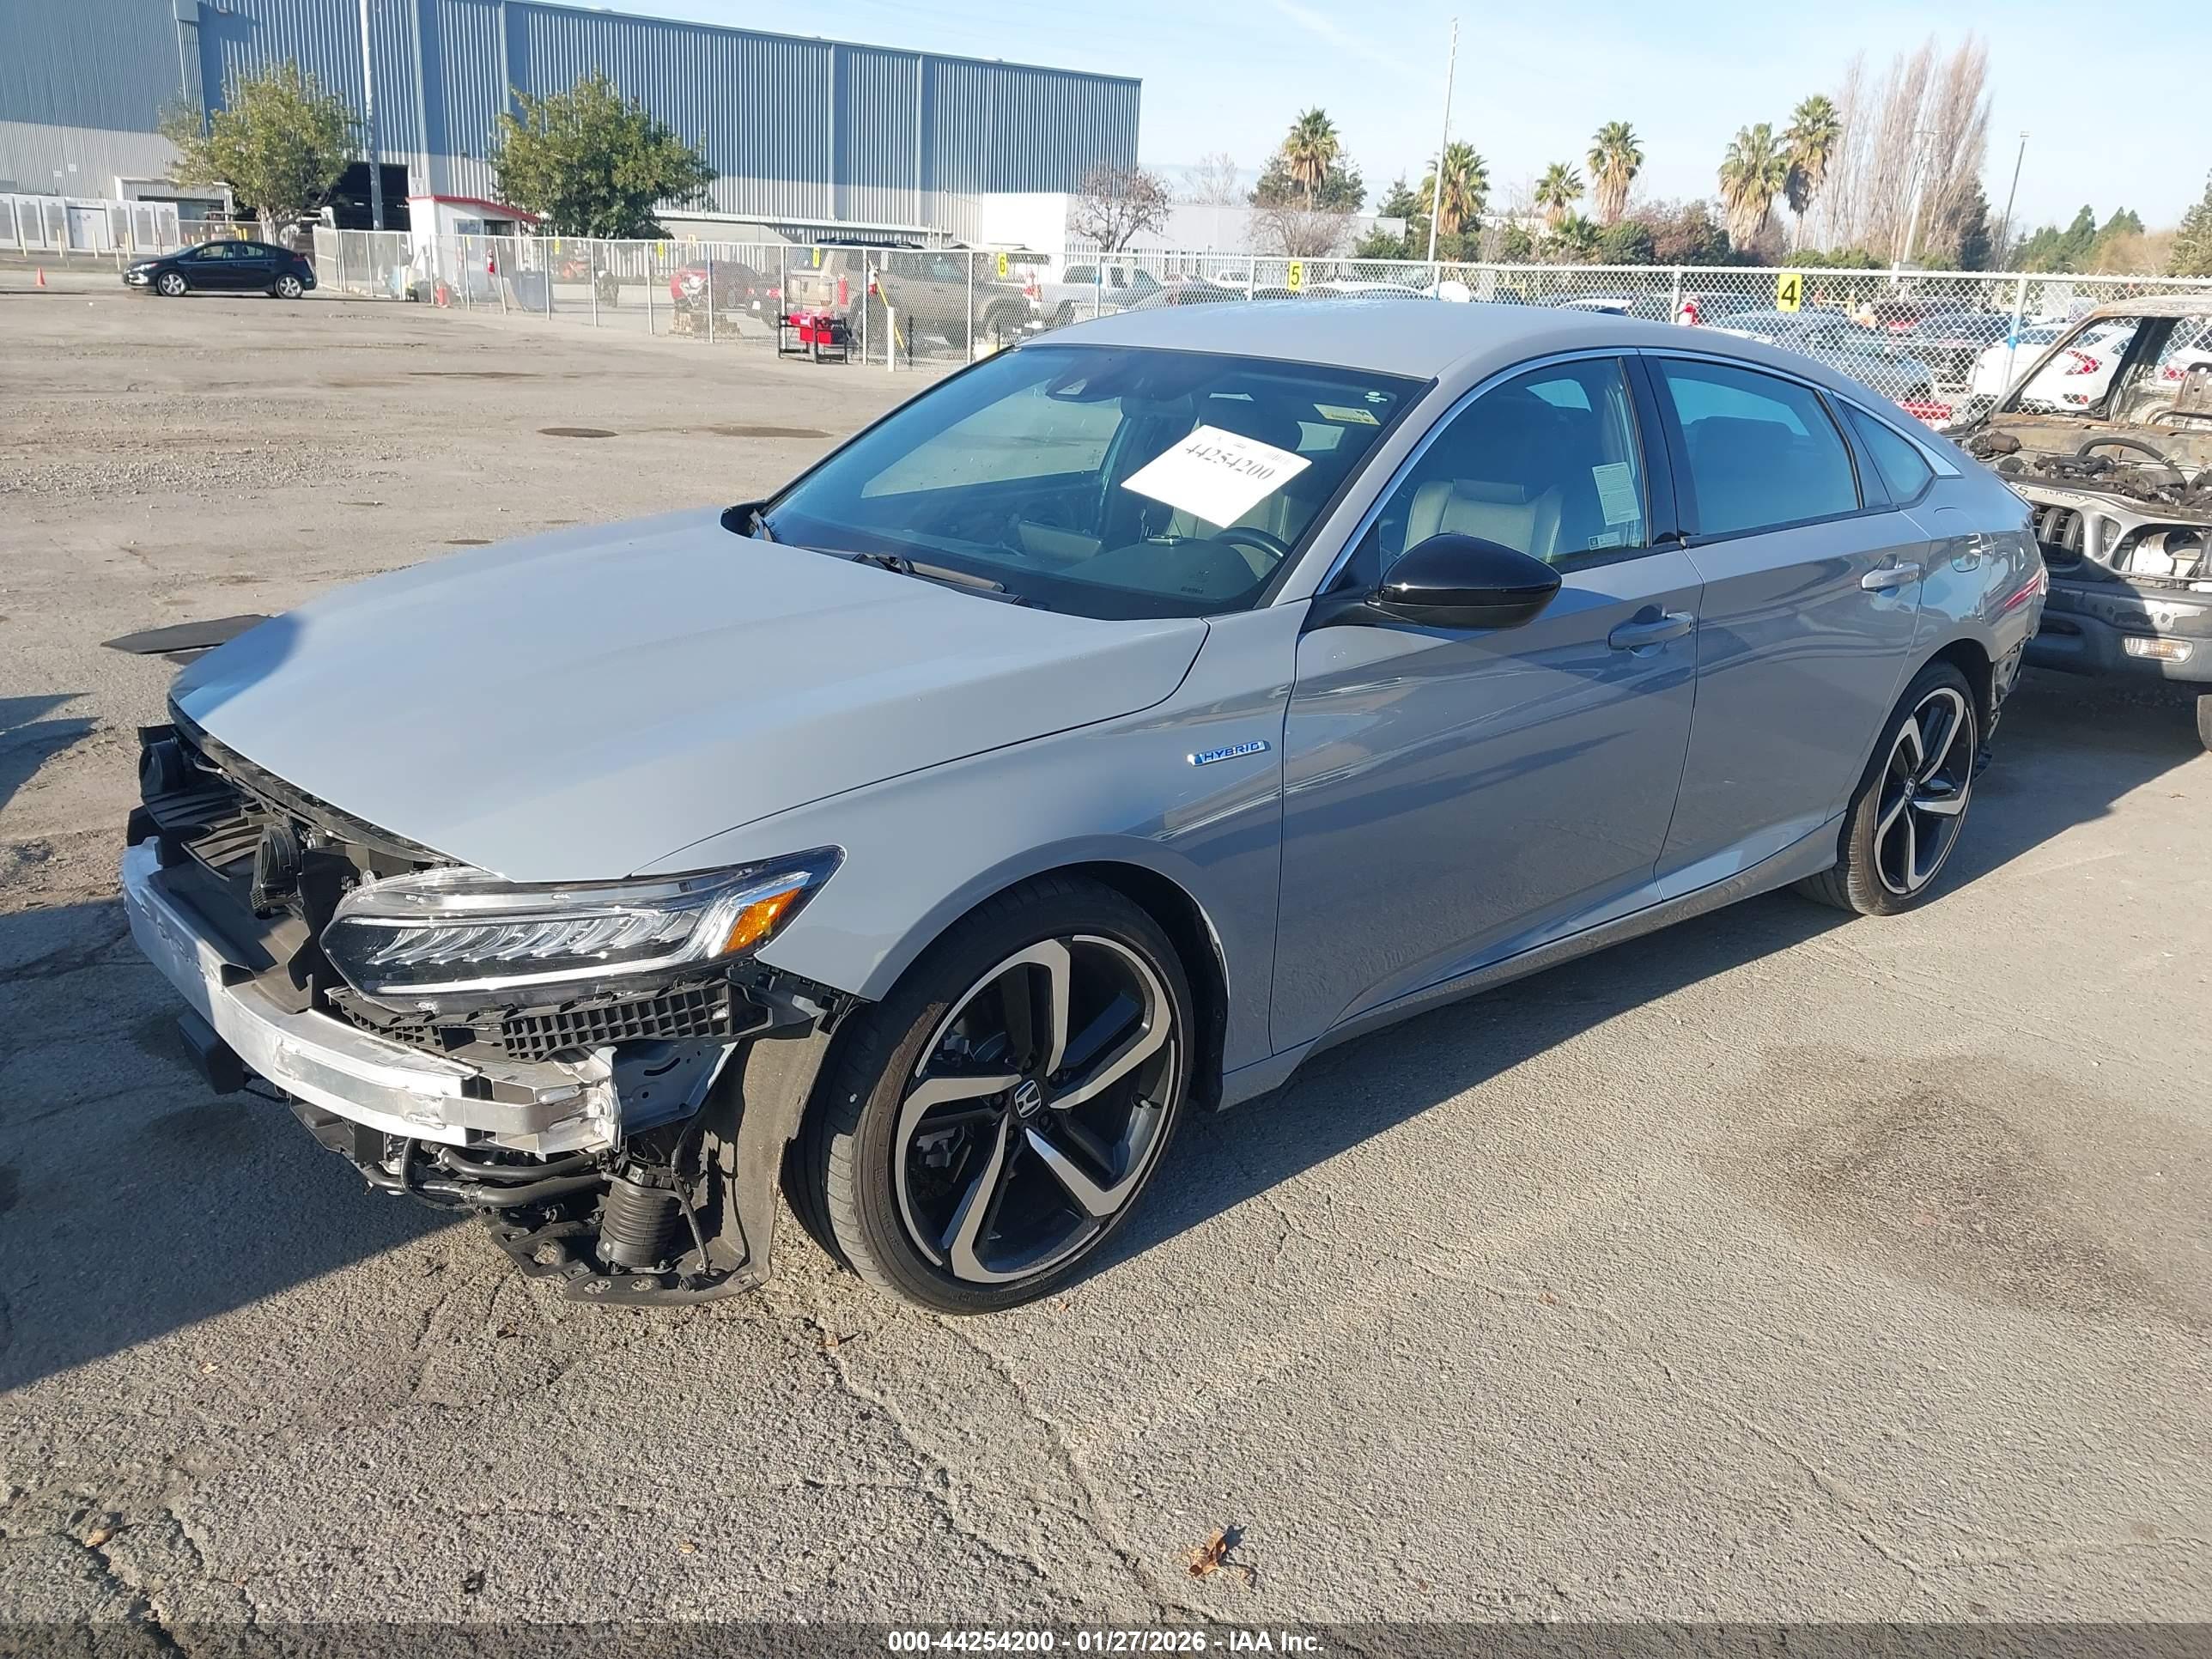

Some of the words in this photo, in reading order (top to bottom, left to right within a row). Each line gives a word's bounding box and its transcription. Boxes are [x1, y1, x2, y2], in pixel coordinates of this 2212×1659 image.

[1000, 257, 1006, 273] 6
[1291, 265, 1300, 286] 5
[1781, 280, 1797, 307] 4
[1186, 444, 1275, 480] 44254200
[1204, 741, 1261, 762] HYBRID
